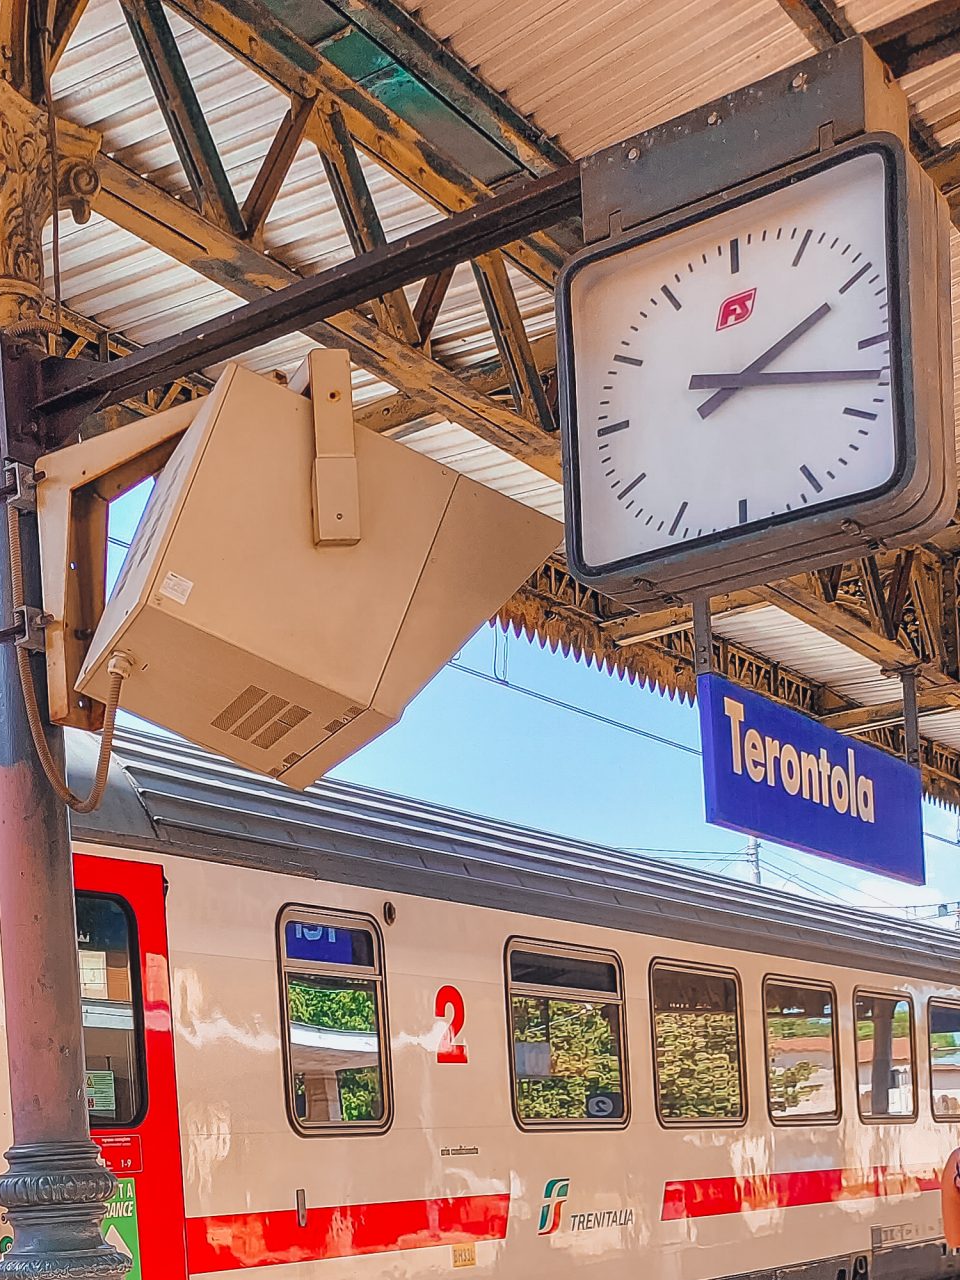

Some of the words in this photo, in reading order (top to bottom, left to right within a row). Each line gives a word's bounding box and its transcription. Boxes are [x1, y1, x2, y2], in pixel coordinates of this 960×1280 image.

[718, 290, 754, 329] FS
[724, 696, 876, 824] Terontola
[435, 985, 468, 1063] 2
[571, 1209, 634, 1232] TRENITALIA
